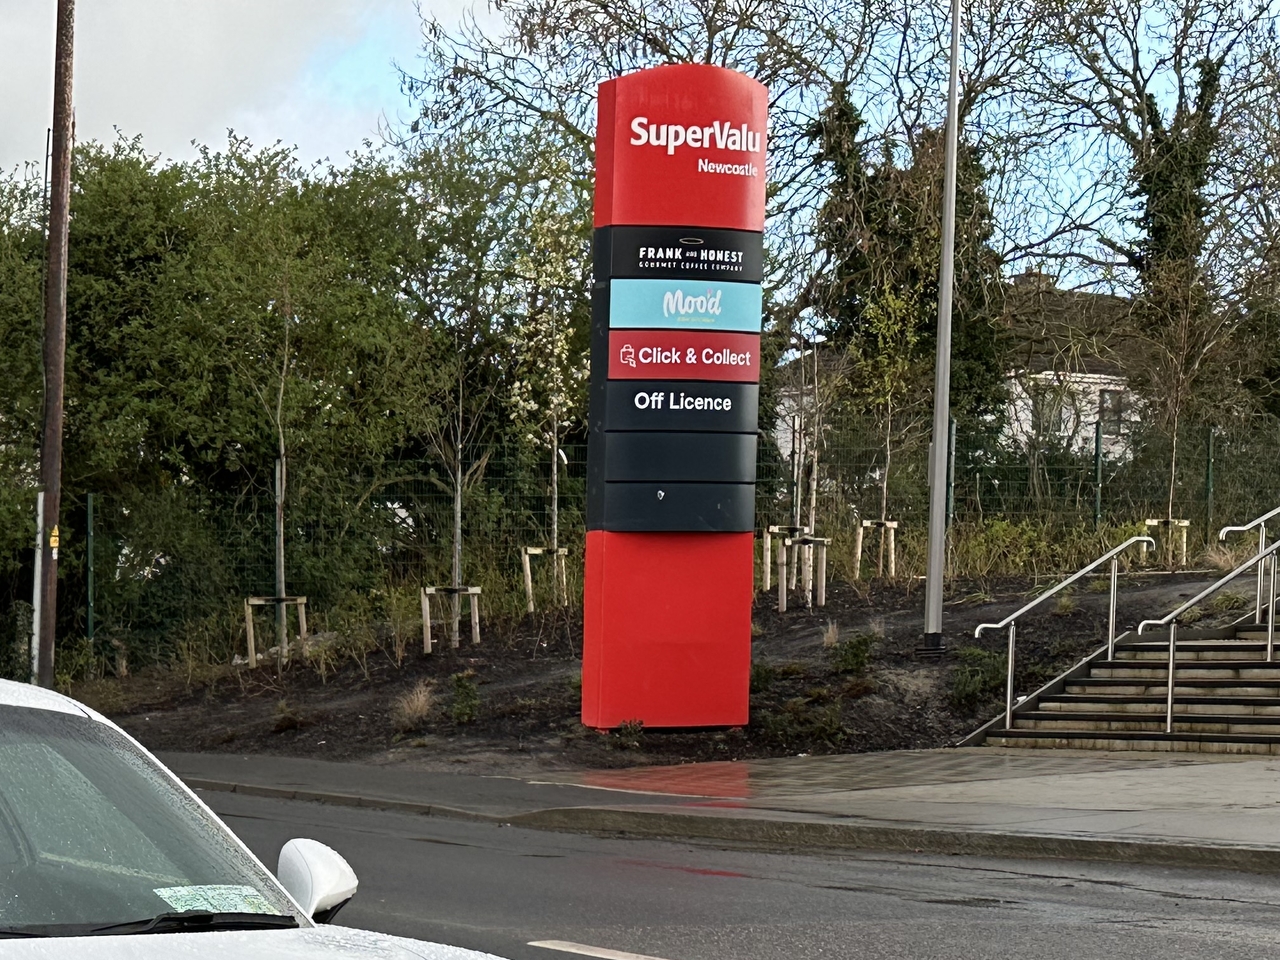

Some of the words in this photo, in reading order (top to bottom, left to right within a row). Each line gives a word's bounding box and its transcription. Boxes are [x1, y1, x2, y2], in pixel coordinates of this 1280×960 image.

[630, 116, 761, 155] SuperValu
[698, 158, 758, 177] Newcastle
[639, 247, 683, 259] FRANK
[700, 249, 744, 263] HONEST
[638, 347, 681, 364] Click
[685, 347, 697, 364] &
[701, 348, 751, 366] Collect
[634, 391, 665, 410] Off
[669, 392, 732, 411] Licence
